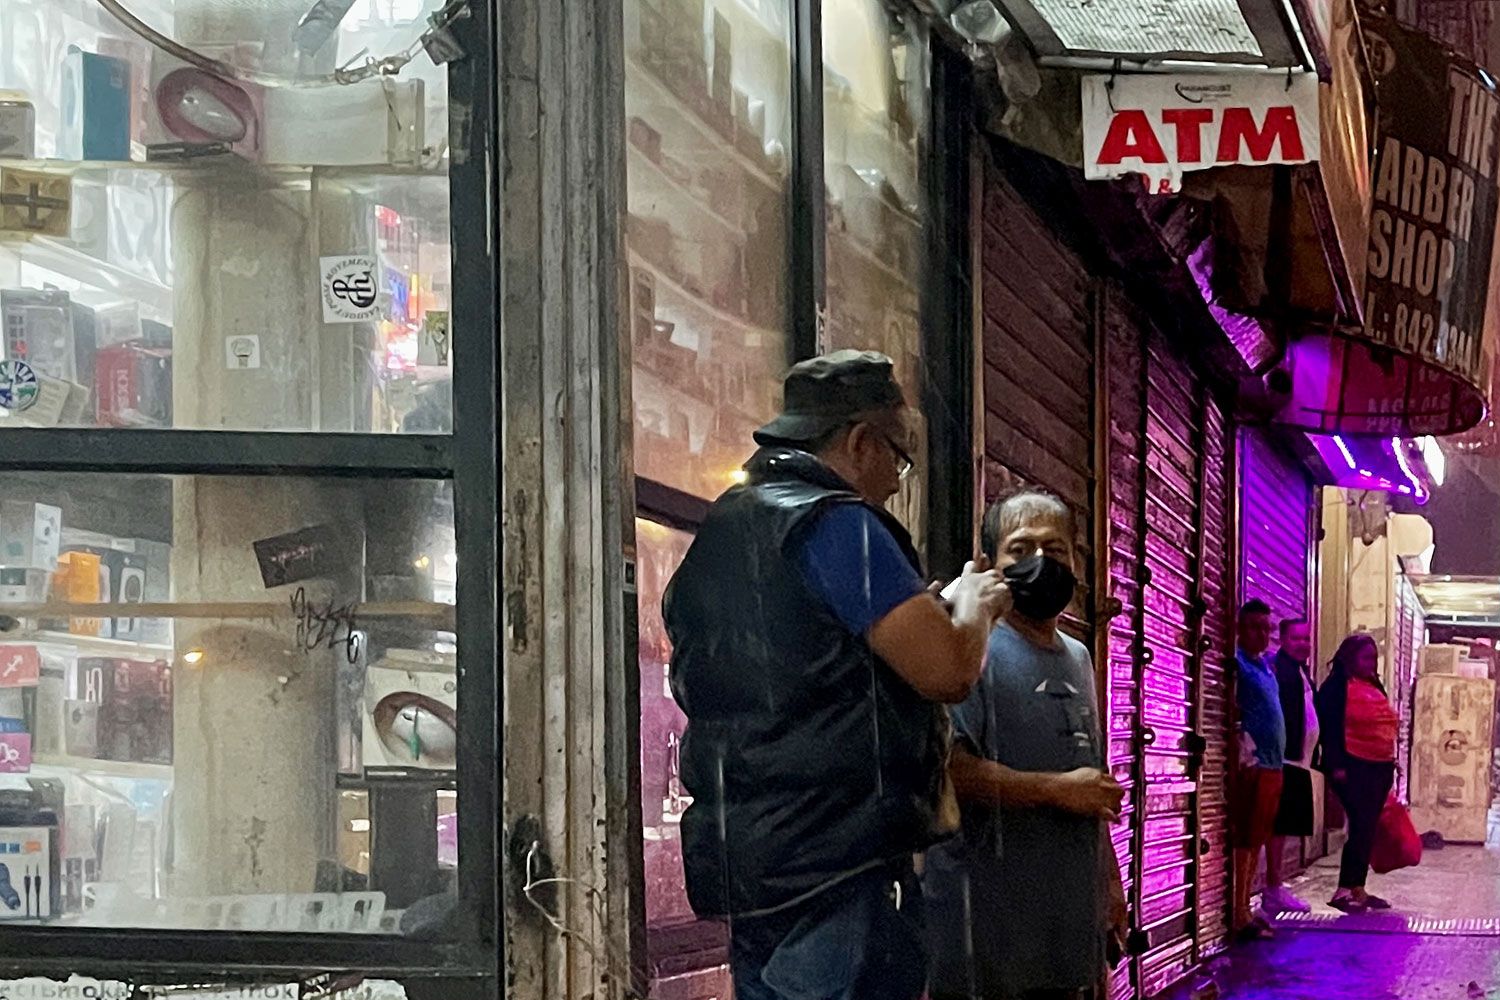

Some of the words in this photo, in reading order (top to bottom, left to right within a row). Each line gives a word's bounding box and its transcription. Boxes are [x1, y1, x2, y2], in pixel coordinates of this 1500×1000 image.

[1097, 106, 1305, 164] ATM
[1449, 70, 1499, 178] THE
[325, 258, 375, 280] MOVEMENT
[1369, 209, 1455, 299] SHOP
